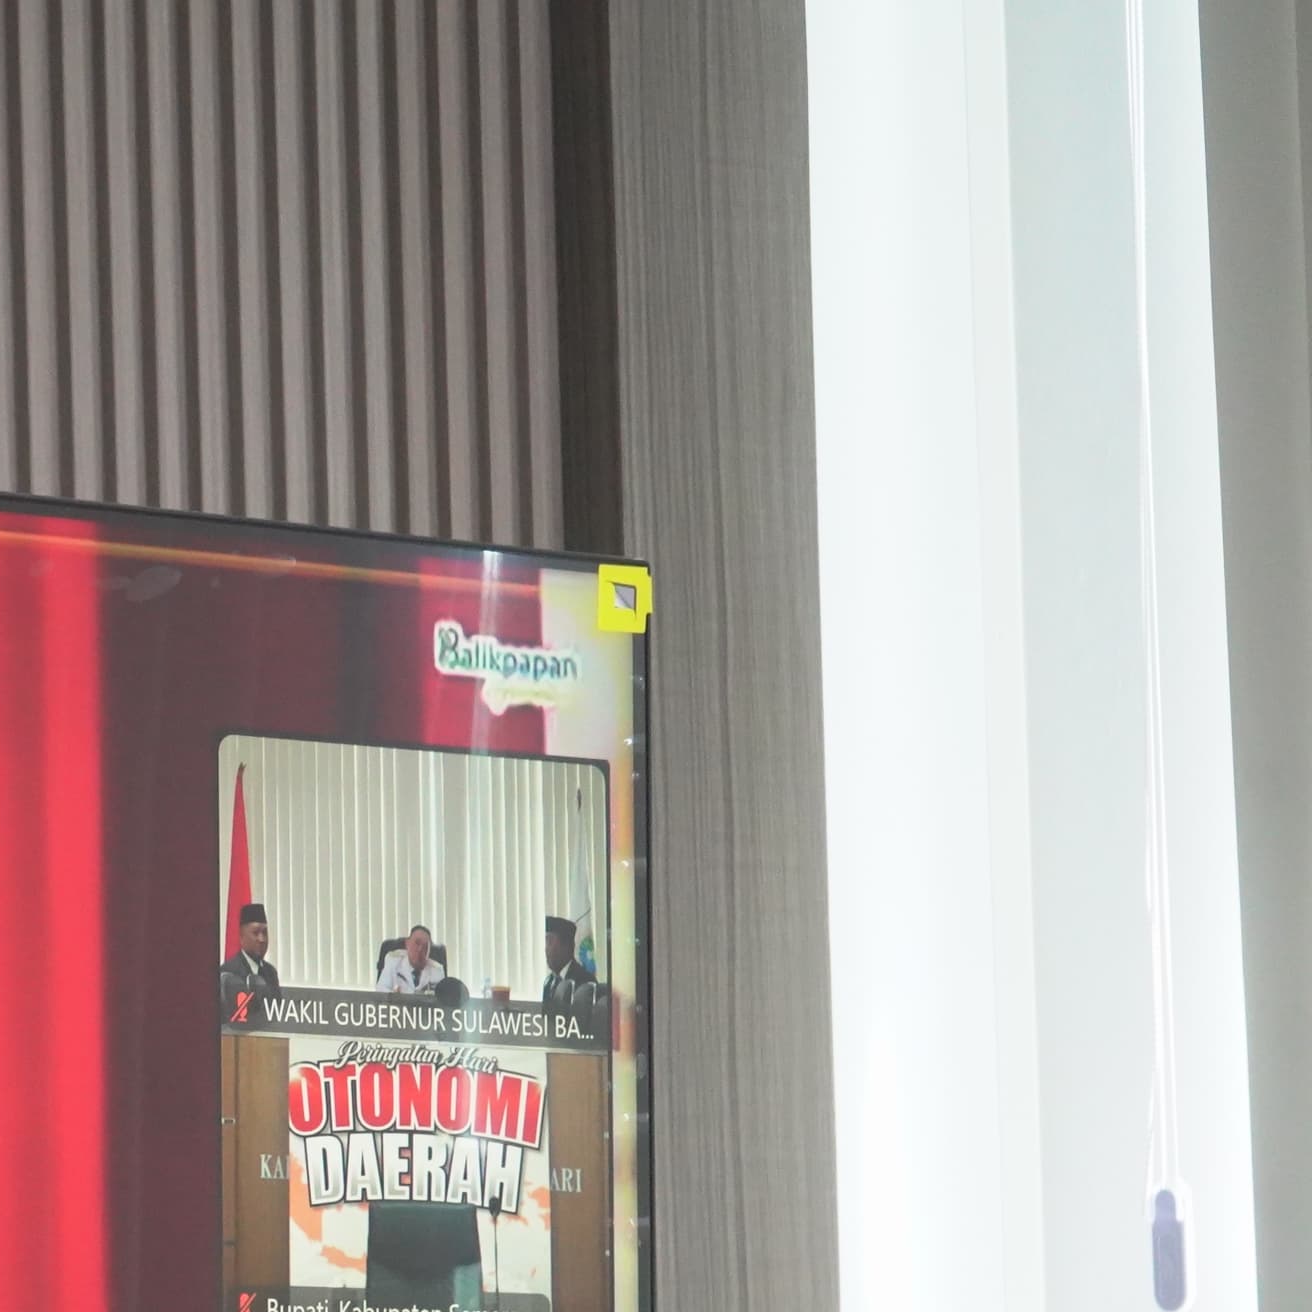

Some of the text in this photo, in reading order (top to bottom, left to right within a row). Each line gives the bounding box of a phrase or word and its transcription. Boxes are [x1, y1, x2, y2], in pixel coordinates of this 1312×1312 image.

[437, 626, 578, 680] Balikpapan
[263, 997, 329, 1025] WAKIL
[334, 1002, 446, 1032] GUBERNUR
[452, 1008, 549, 1038] SULAWESI
[288, 1061, 546, 1149] OTONOMI
[305, 1131, 524, 1215] DAERAH
